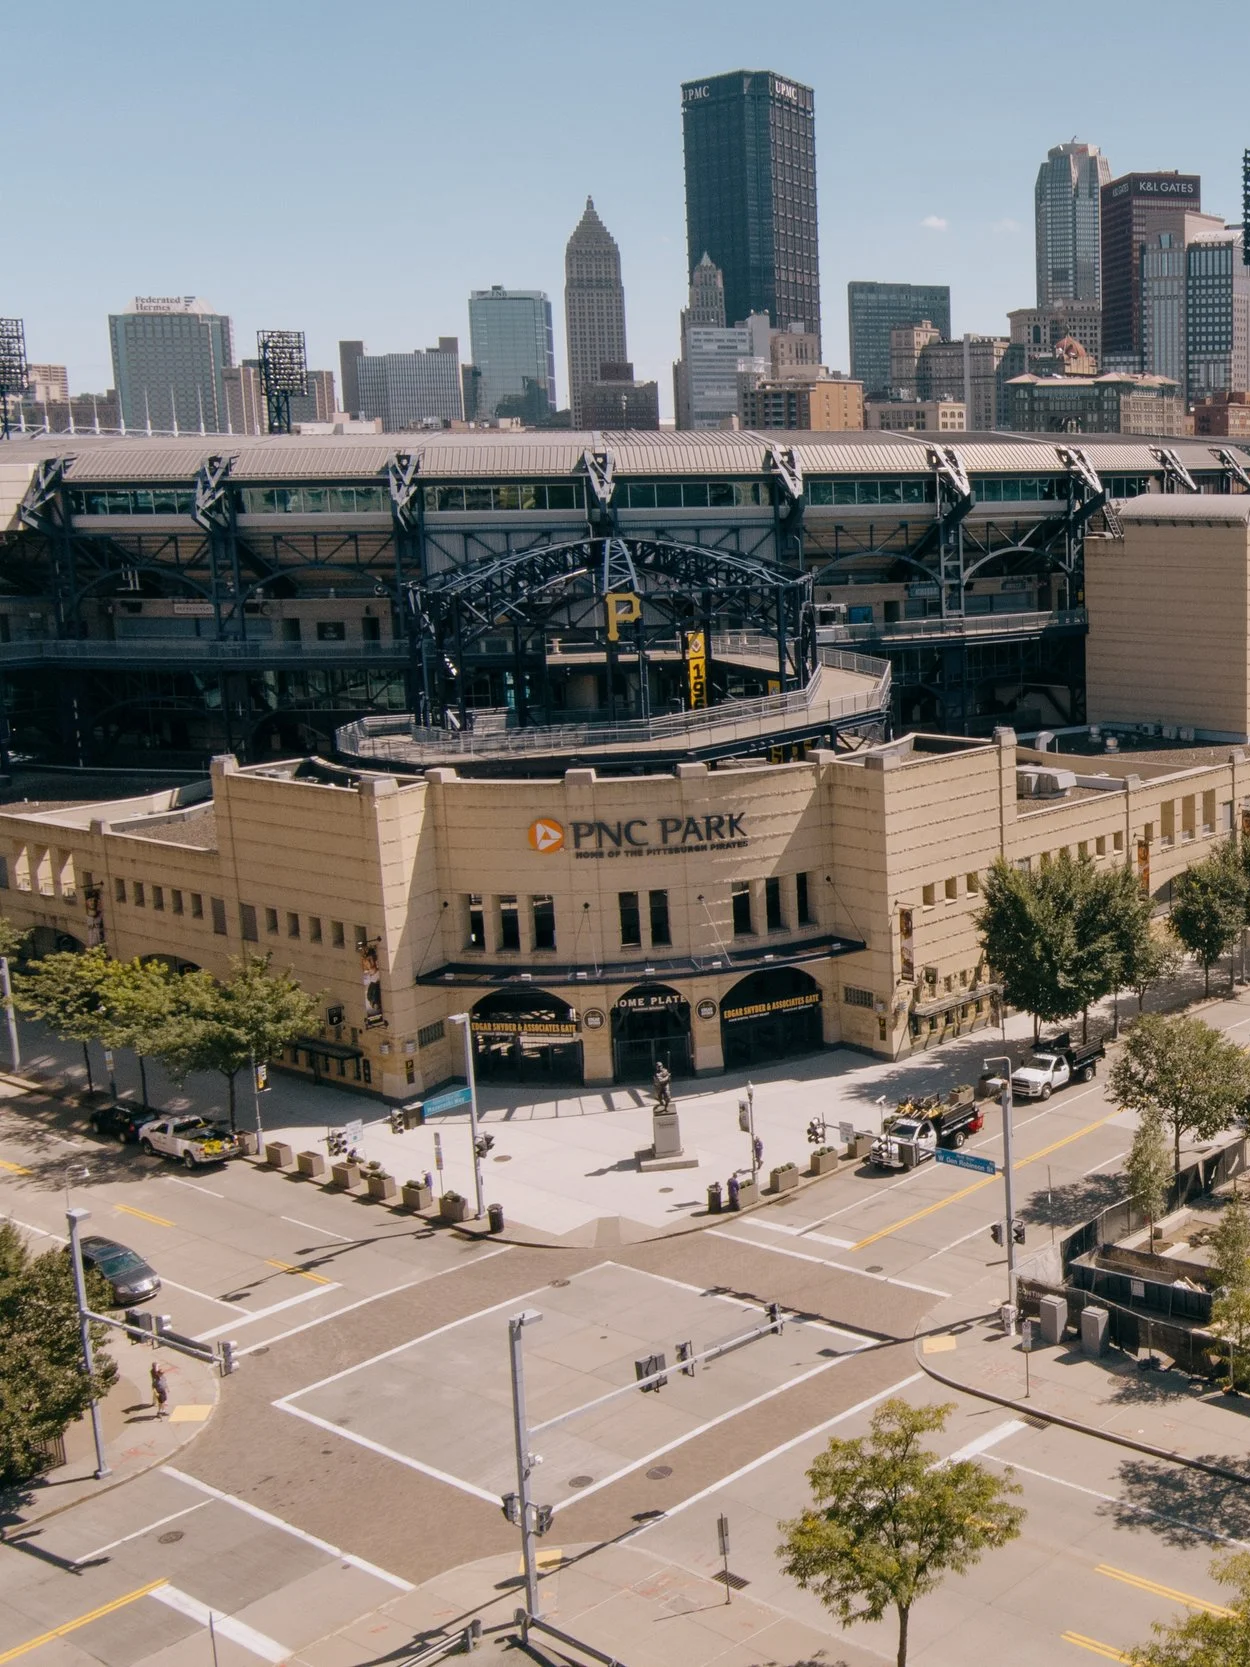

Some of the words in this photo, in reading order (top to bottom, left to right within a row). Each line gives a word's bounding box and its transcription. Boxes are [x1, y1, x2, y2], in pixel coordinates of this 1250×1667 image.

[683, 86, 710, 100] UPMC
[775, 80, 798, 100] UPMC
[1140, 181, 1159, 192] K&L
[1160, 182, 1194, 193] GATES
[135, 295, 181, 304] Federated
[136, 303, 171, 311] Hermes
[605, 592, 641, 641] P
[569, 819, 649, 849] PNC
[657, 812, 748, 844] PARK
[576, 851, 604, 859] HOME
[625, 849, 643, 857] THE
[646, 844, 708, 856] PITTSBURGH
[710, 840, 749, 851] PIRATES
[650, 995, 687, 1005] PLATE
[724, 1007, 743, 1019] EDGAR
[743, 1004, 767, 1016] SNYDER
[772, 996, 805, 1009] ASSOCIATES
[805, 994, 820, 1004] GATE
[471, 1022, 492, 1031] EDGAR
[493, 1023, 517, 1032] SNYDER
[524, 1023, 560, 1032] ASSOCIATES
[561, 1024, 577, 1032] GATE
[938, 1154, 945, 1162] W
[959, 1159, 985, 1171] Robinson
